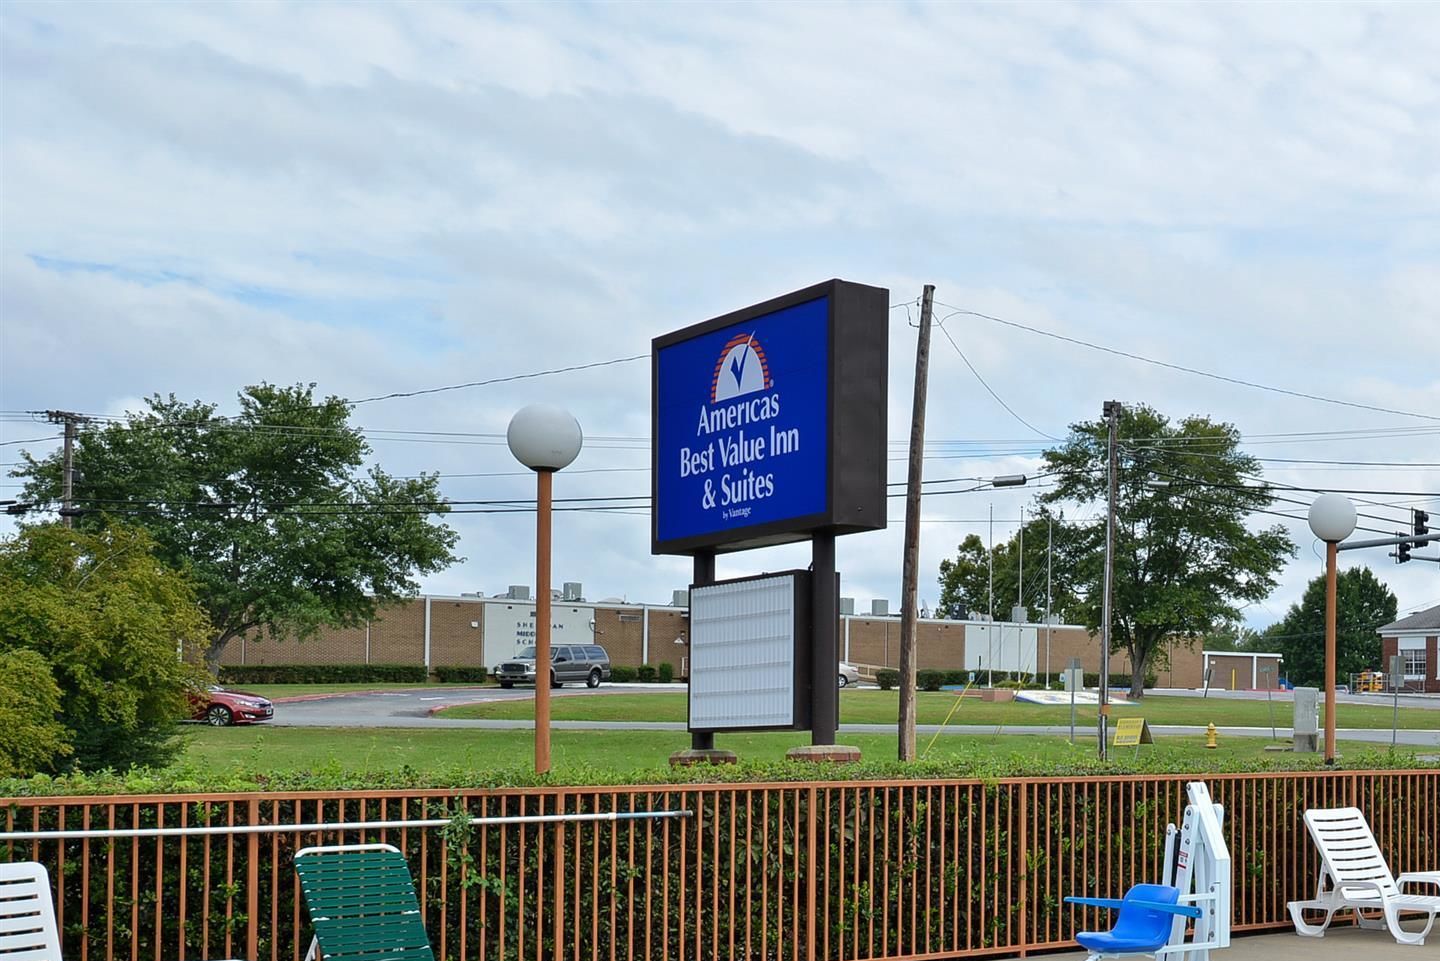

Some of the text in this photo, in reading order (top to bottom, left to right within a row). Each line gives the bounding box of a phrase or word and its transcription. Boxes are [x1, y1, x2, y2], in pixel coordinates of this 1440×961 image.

[697, 393, 780, 437] Americas
[680, 425, 799, 478] Best Value Inn
[702, 467, 774, 510] & Suites
[722, 507, 751, 520] by Vantage
